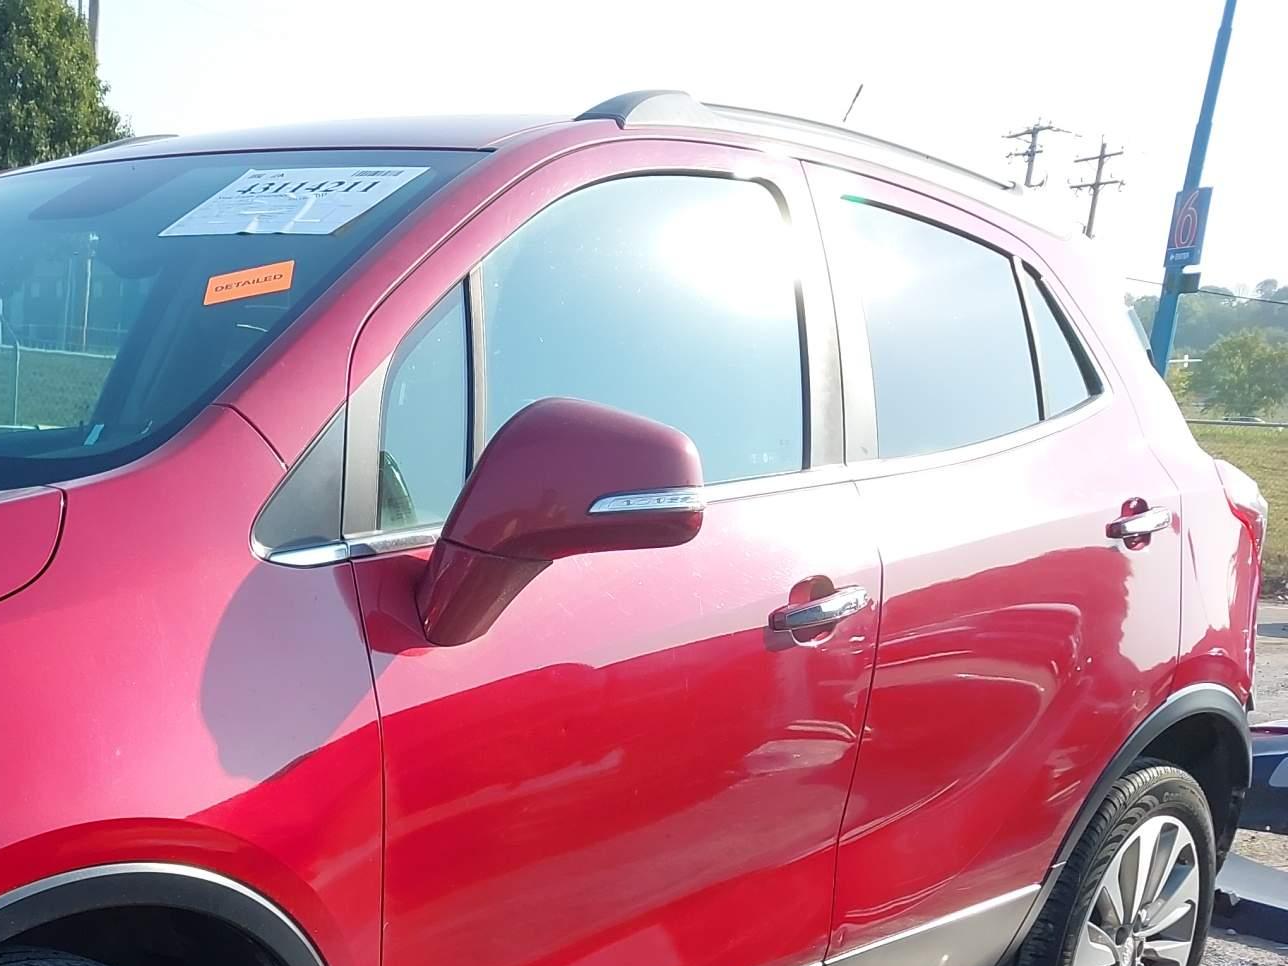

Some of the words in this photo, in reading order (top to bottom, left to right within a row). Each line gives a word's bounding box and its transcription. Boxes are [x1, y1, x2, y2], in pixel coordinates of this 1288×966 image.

[236, 180, 381, 195] 43114211
[1175, 190, 1199, 249] 6
[215, 273, 284, 292] DETAILED
